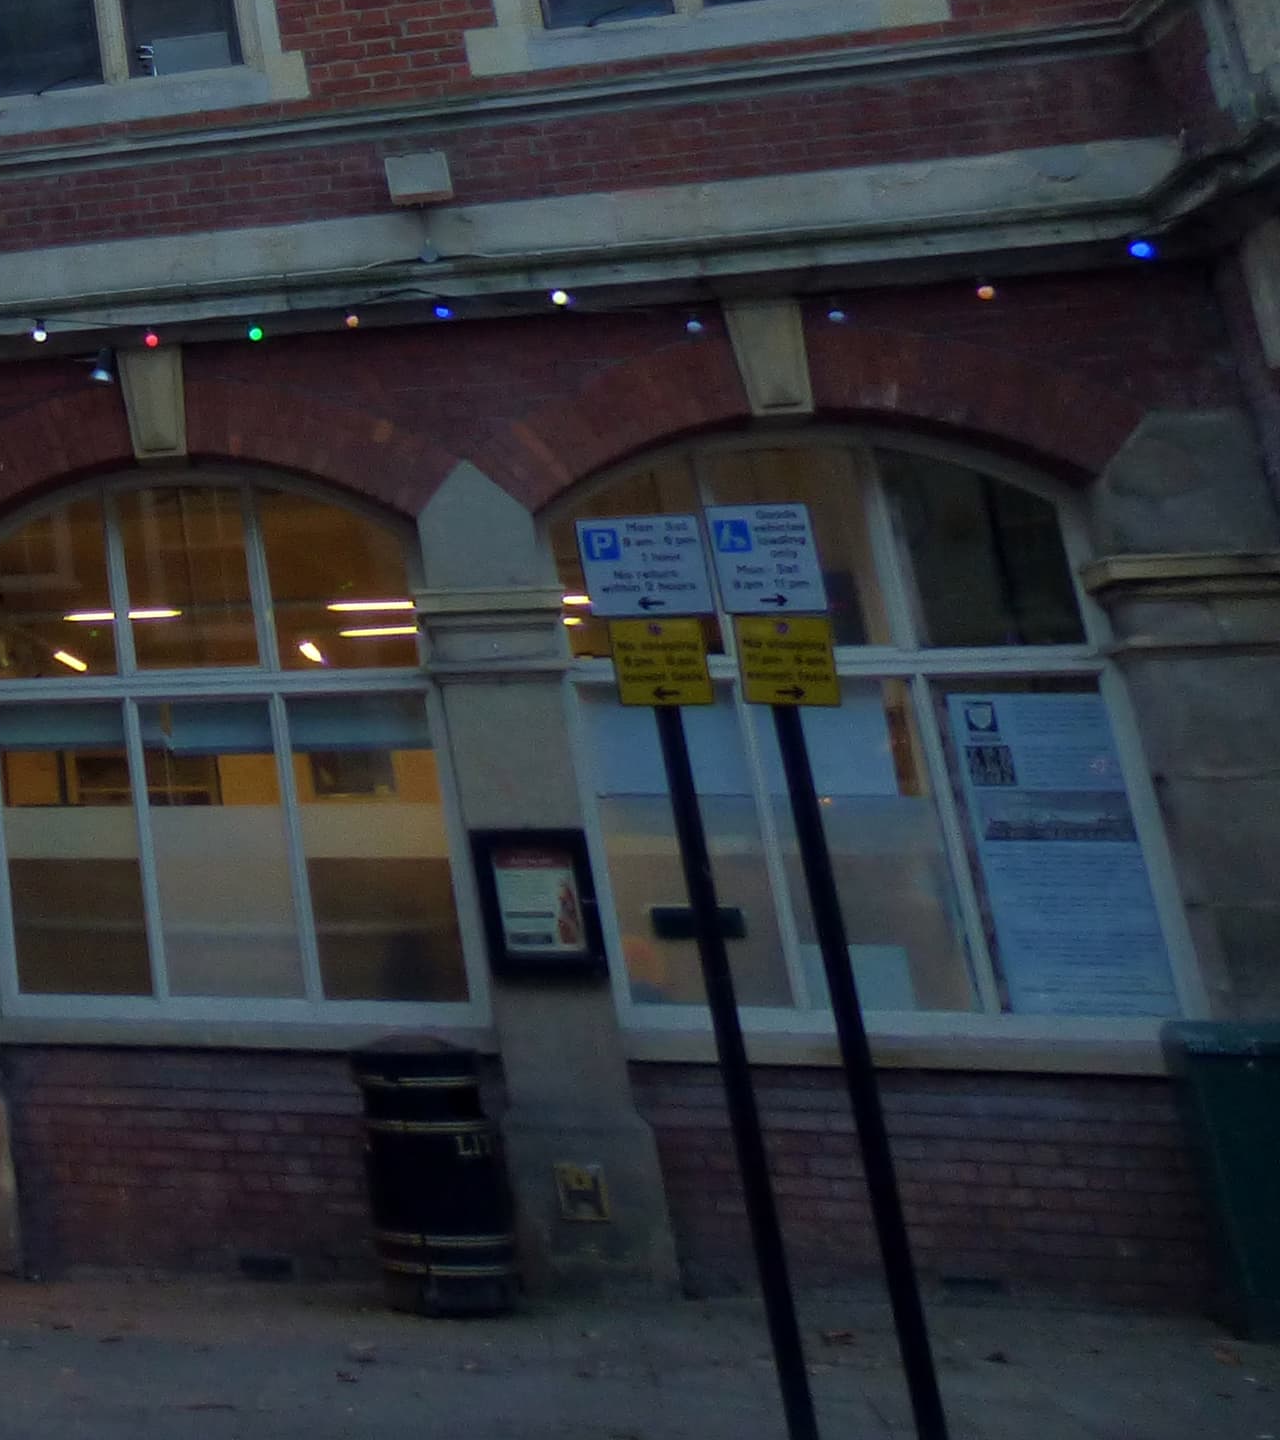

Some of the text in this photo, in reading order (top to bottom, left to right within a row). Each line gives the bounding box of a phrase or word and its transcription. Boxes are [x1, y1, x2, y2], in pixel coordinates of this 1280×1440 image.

[625, 522, 653, 532] Mon
[591, 531, 613, 559] P
[736, 564, 765, 574] Mon
